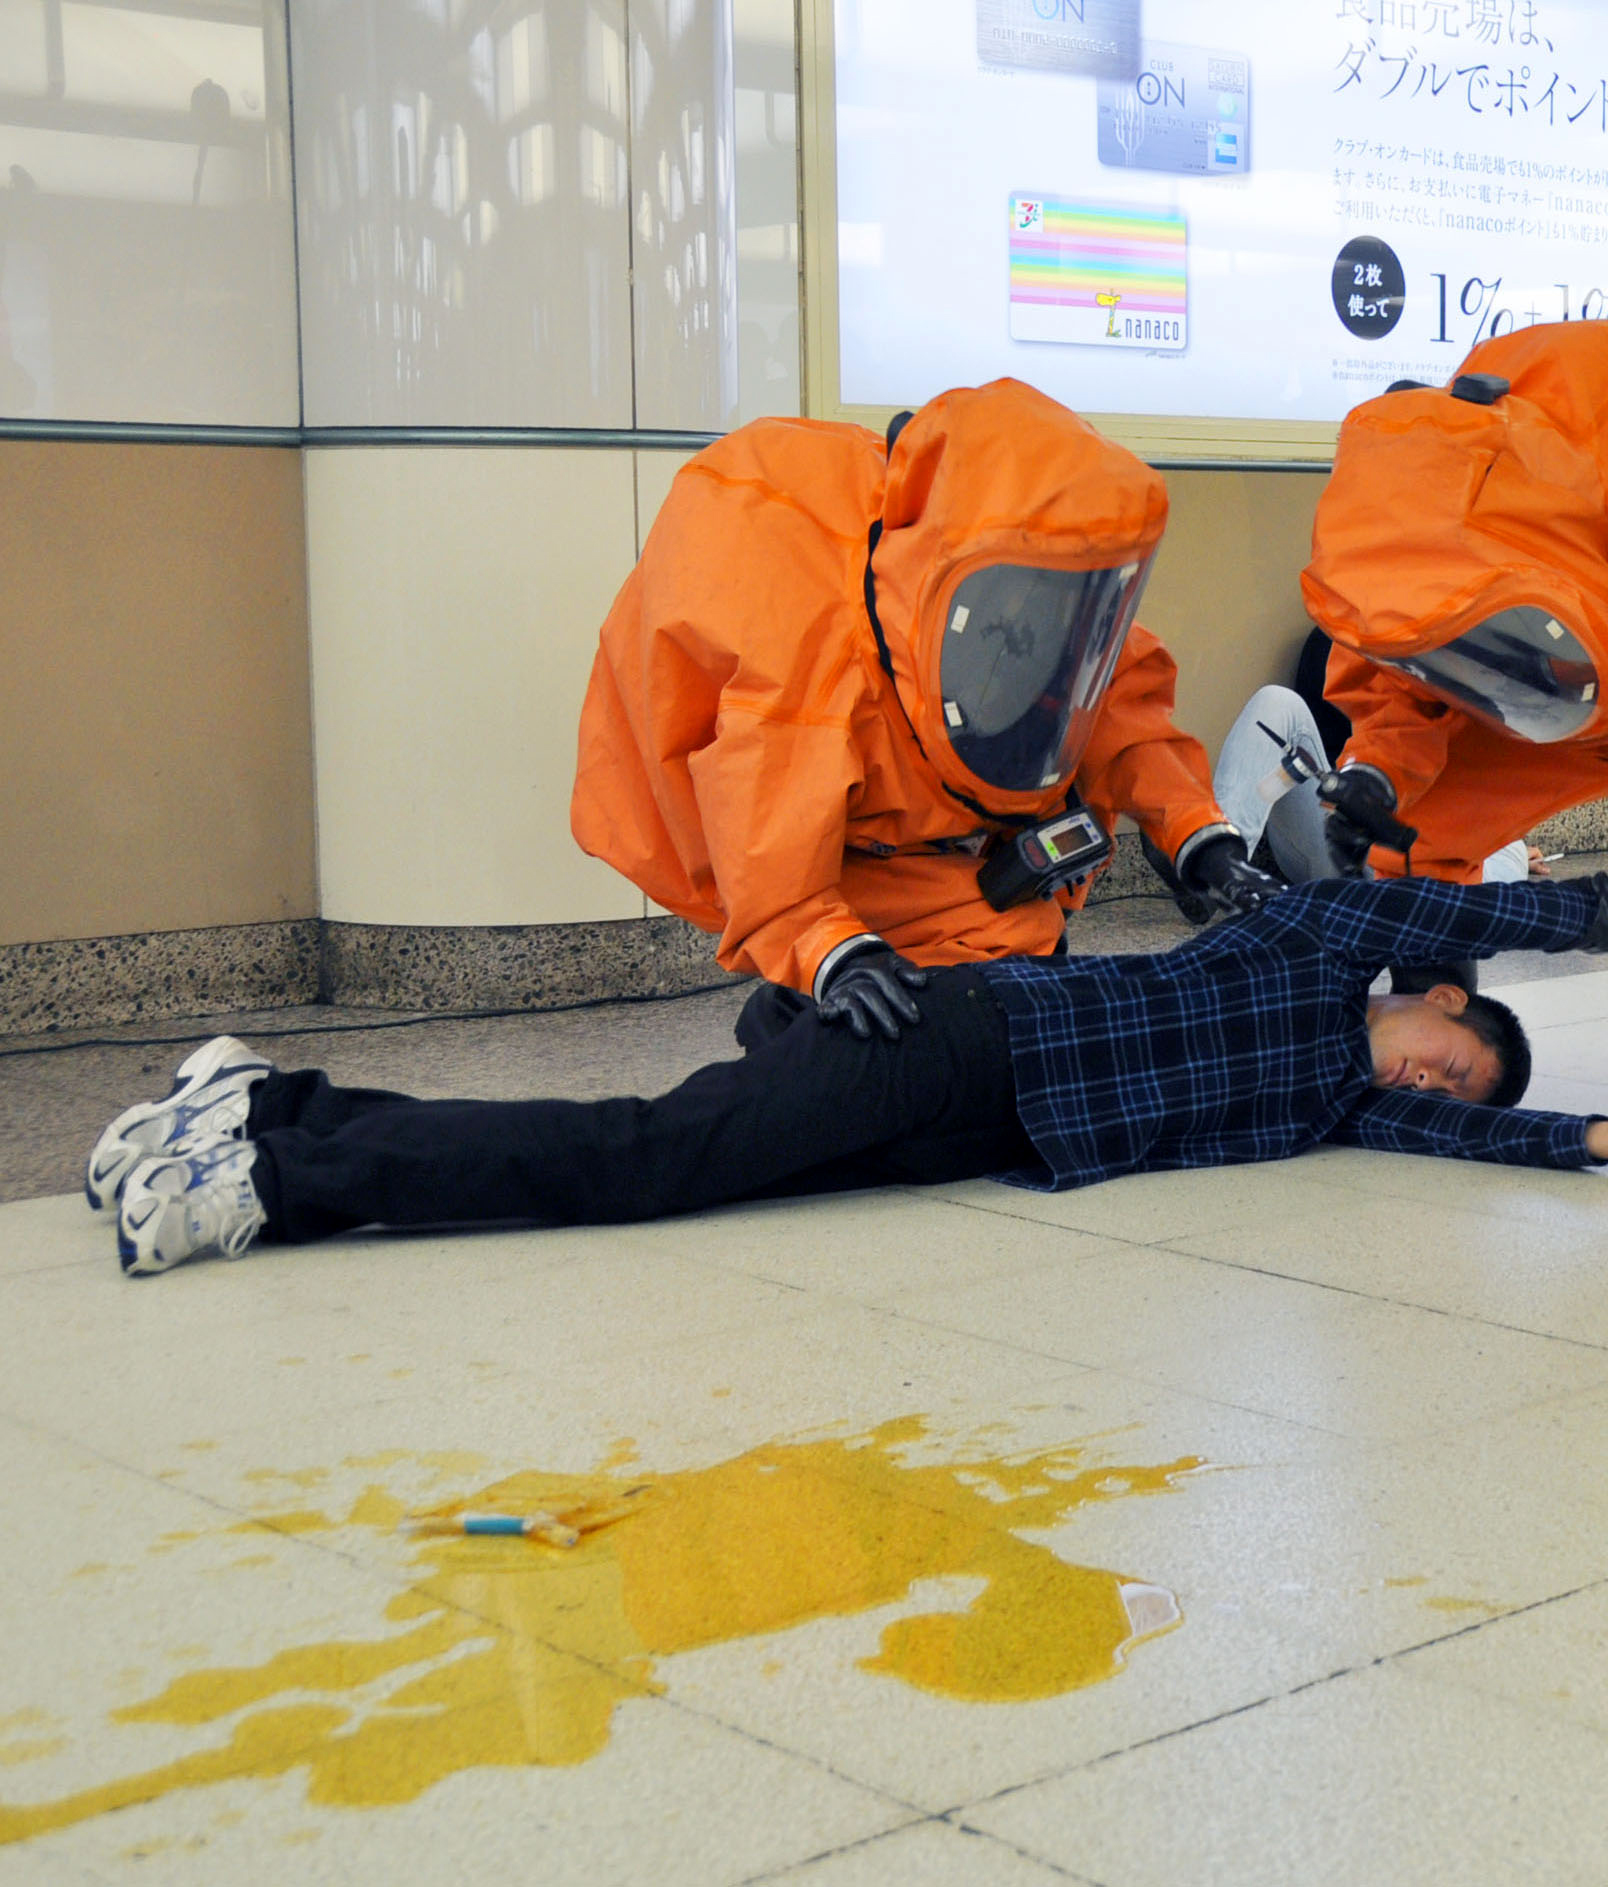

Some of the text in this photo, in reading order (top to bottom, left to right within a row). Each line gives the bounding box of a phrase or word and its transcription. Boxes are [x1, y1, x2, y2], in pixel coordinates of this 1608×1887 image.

[1136, 72, 1186, 109] ON
[1353, 263, 1384, 288] 2枚
[1347, 293, 1390, 319] 使って
[1125, 317, 1180, 342] nanaco
